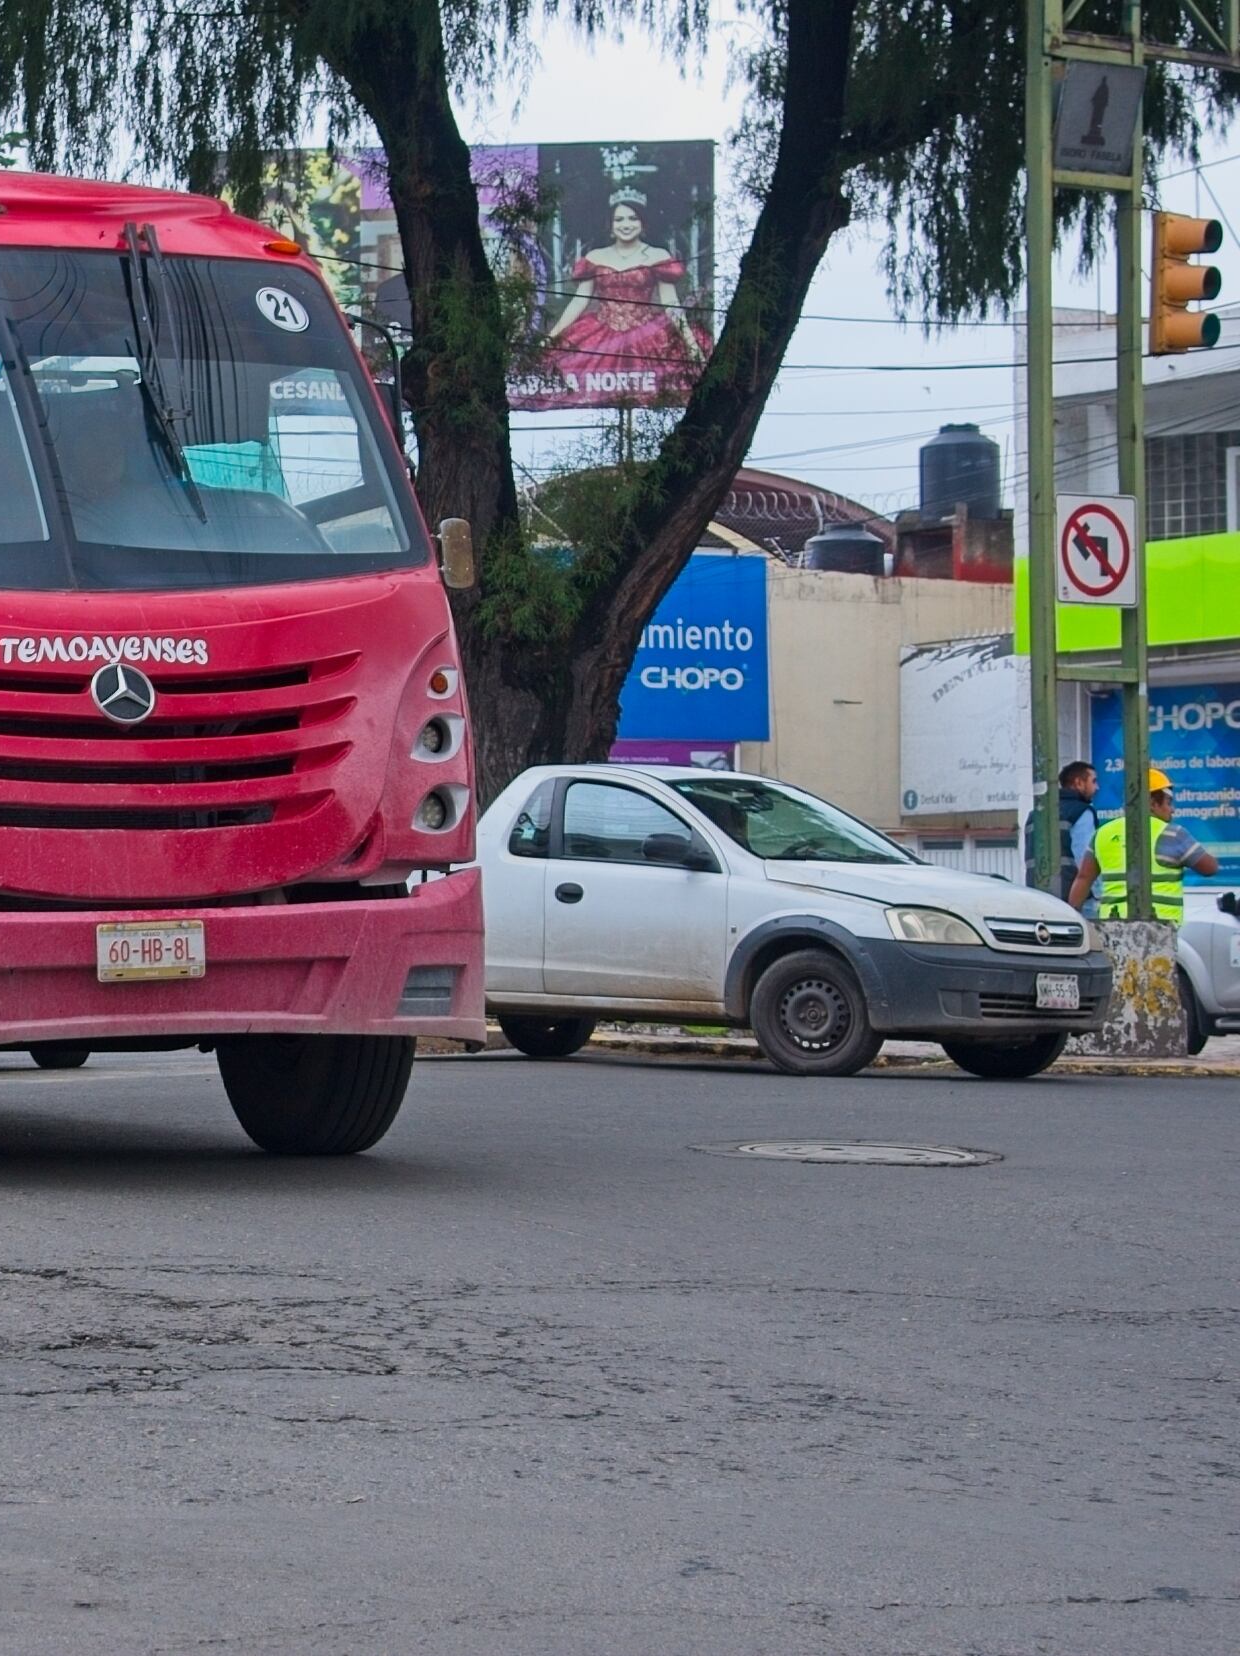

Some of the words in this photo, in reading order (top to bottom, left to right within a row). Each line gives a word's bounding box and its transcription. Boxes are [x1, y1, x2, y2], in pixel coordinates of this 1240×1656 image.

[266, 293, 300, 325] 21
[585, 371, 656, 392] NORTE
[0, 635, 209, 664] TEMOAYENSES
[640, 667, 744, 690] CHOPO
[932, 660, 998, 702] DENTAL
[1150, 755, 1186, 769] tudios
[1188, 756, 1203, 769] de
[109, 937, 196, 964] 60-HB-8L
